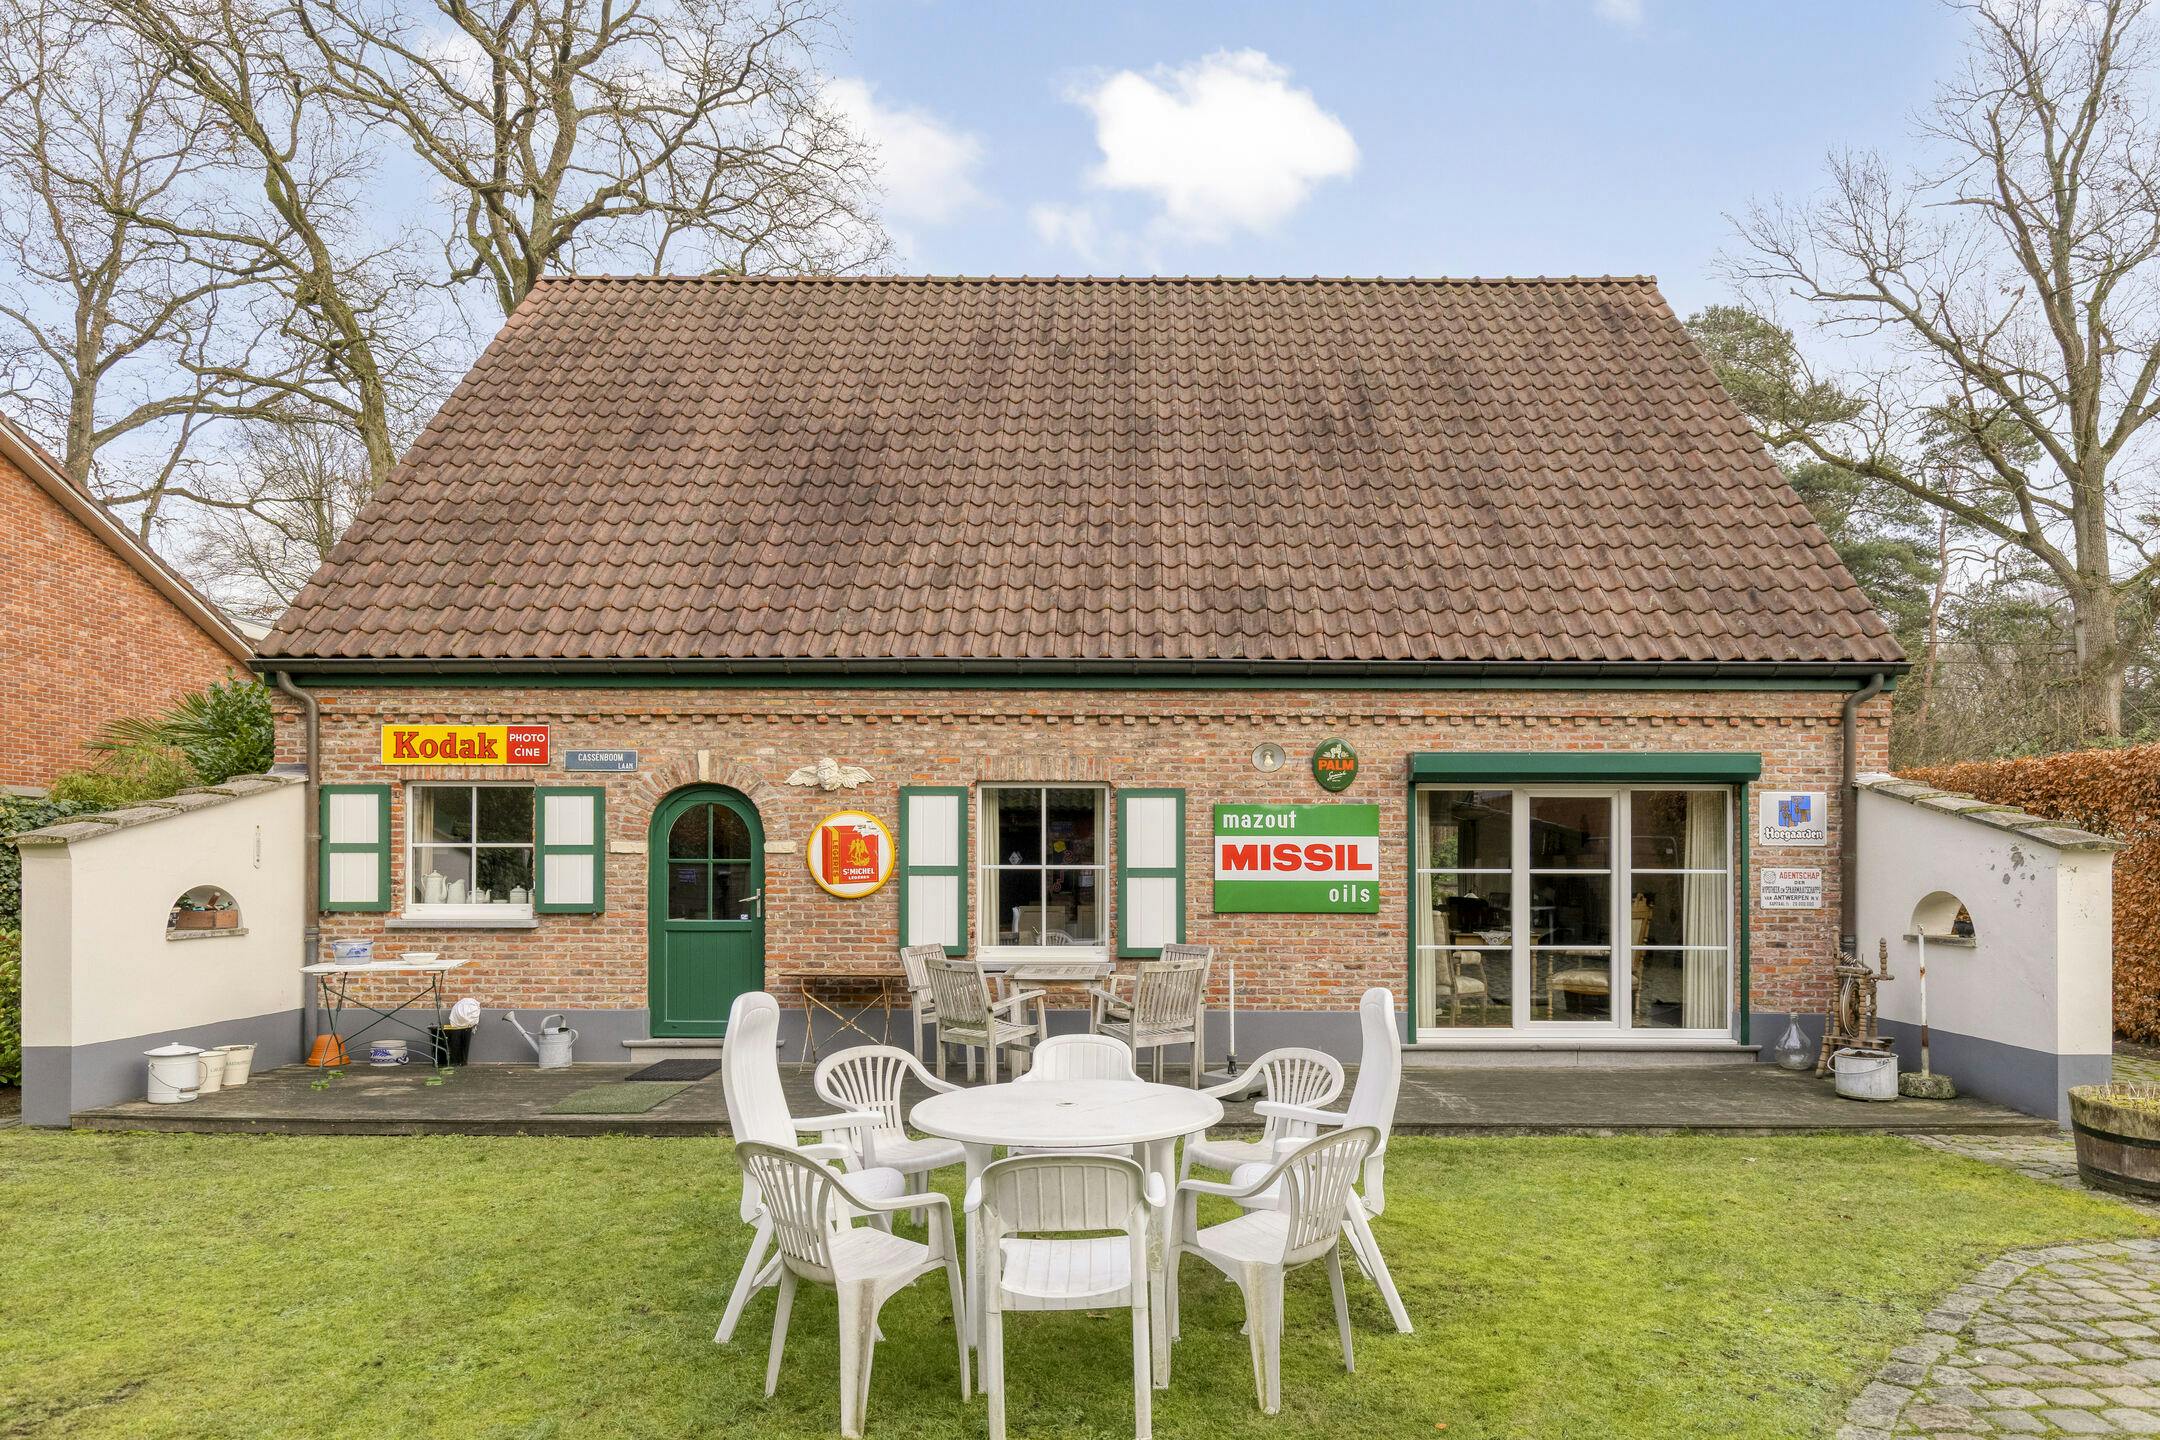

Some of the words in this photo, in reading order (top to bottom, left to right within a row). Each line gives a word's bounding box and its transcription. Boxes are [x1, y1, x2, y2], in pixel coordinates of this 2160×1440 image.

[393, 731, 498, 759] Kodak
[509, 733, 546, 743] PHOTO
[514, 747, 541, 757] CINE
[577, 753, 624, 762] CASSENBOOM
[1318, 758, 1355, 771] PALM
[1222, 810, 1297, 829] mazout
[1764, 826, 1823, 841] Hoegaarden
[1222, 844, 1372, 871] MISSIL
[1328, 884, 1371, 903] oils
